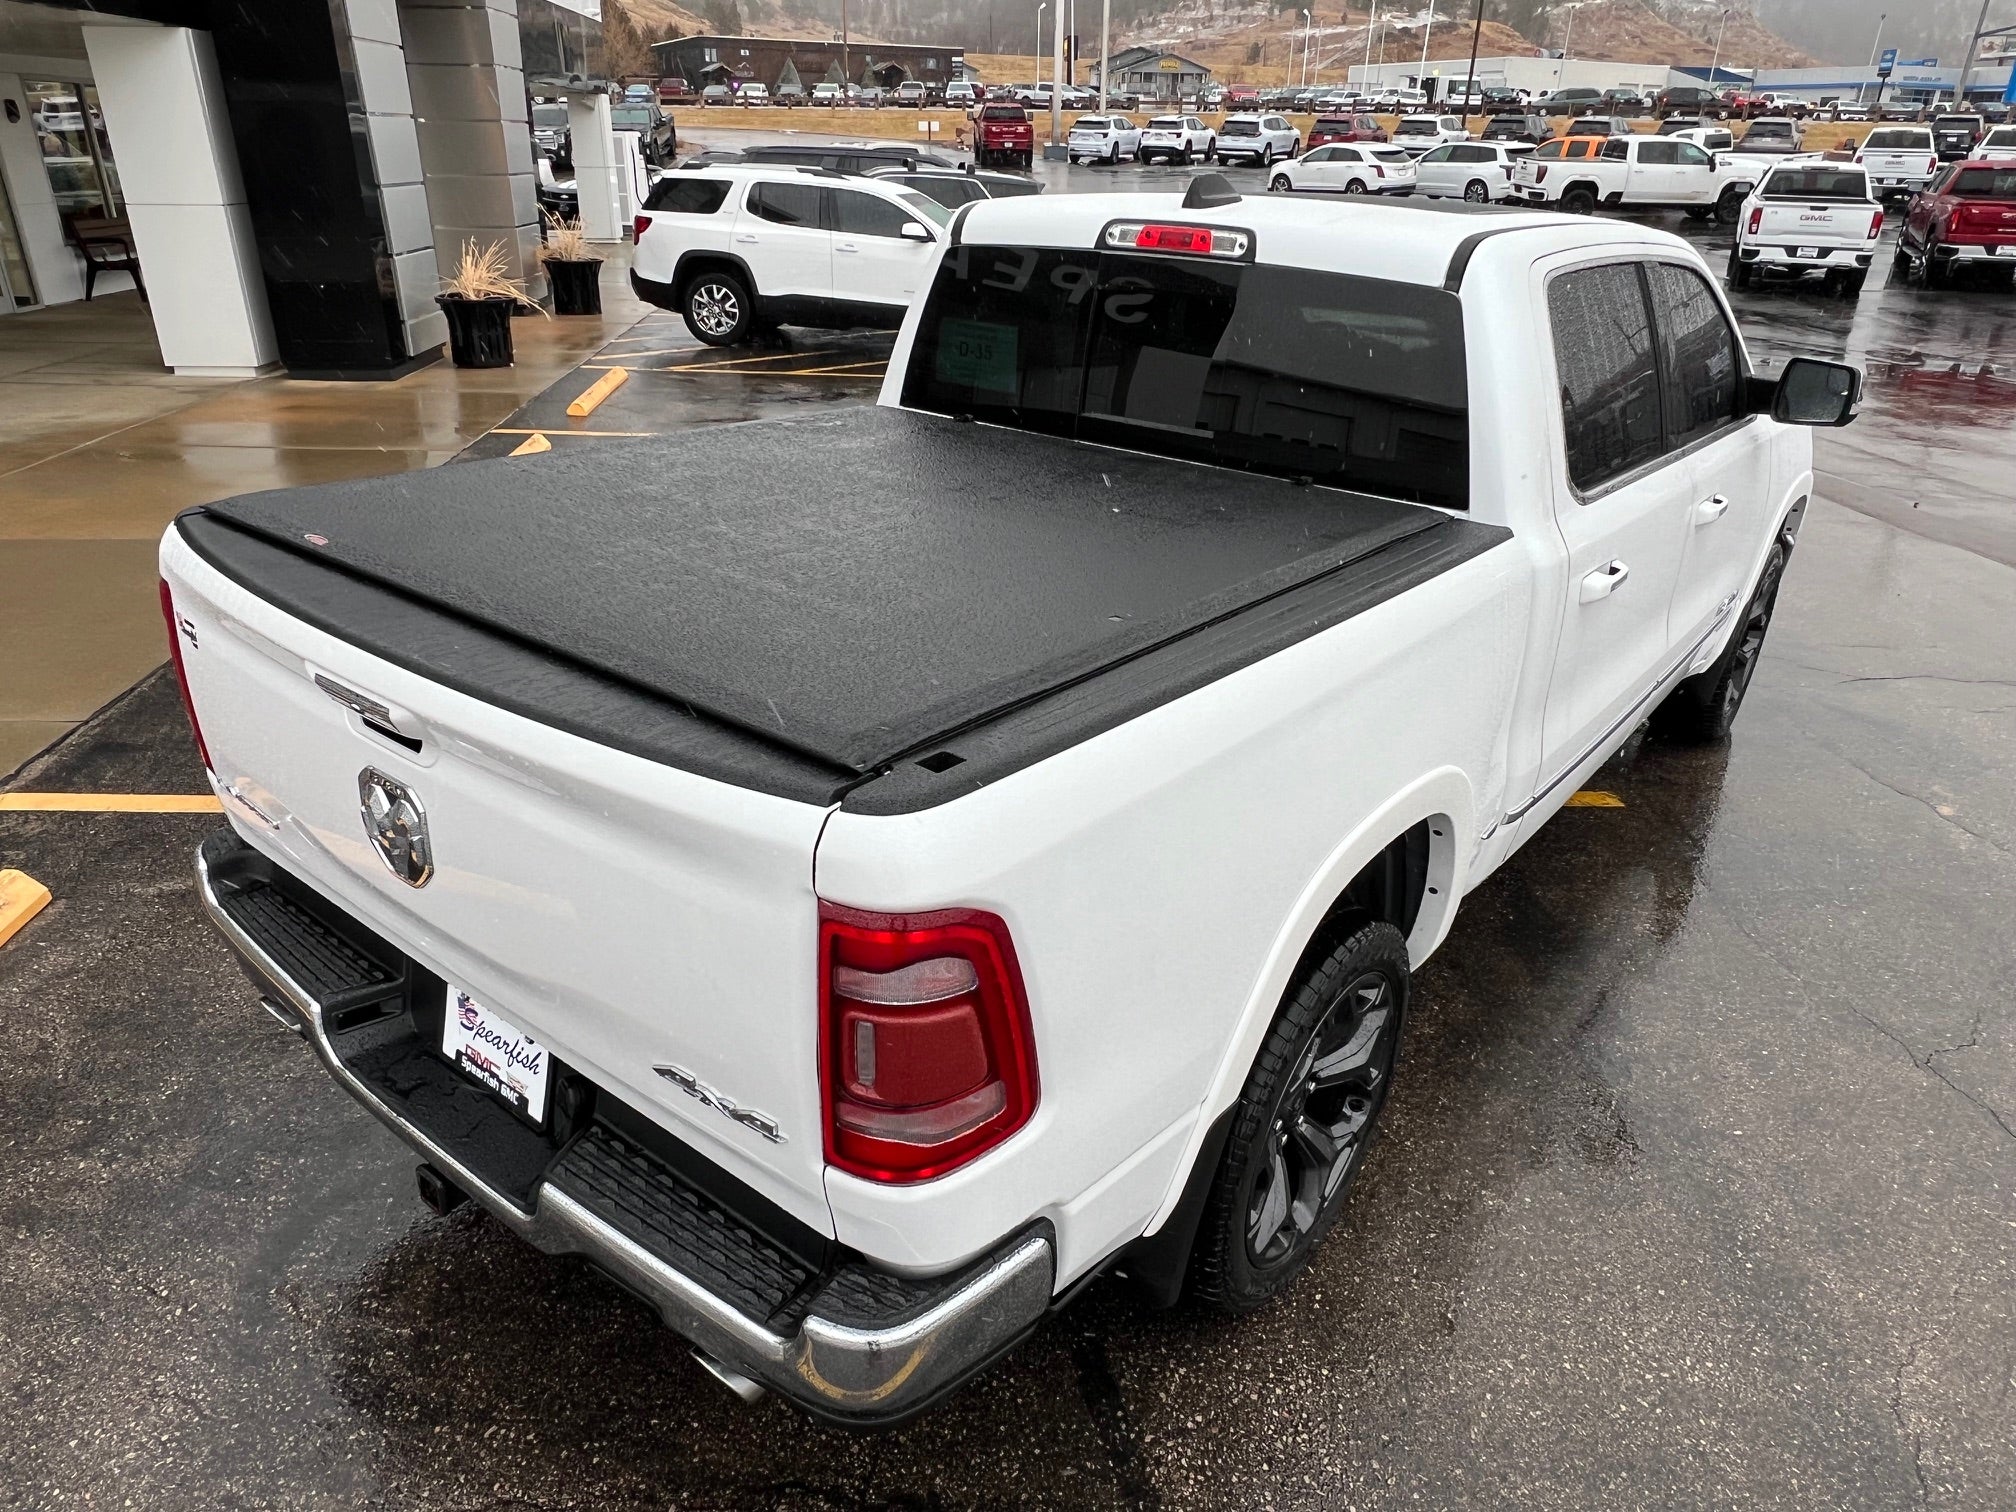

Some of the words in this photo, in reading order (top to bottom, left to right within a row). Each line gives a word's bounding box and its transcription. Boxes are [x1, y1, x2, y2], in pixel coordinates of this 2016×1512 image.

[1800, 214, 1833, 222] GMC
[459, 1006, 542, 1076] Spearfish
[460, 1054, 500, 1092] Spearfish
[500, 1083, 520, 1106] GMC
